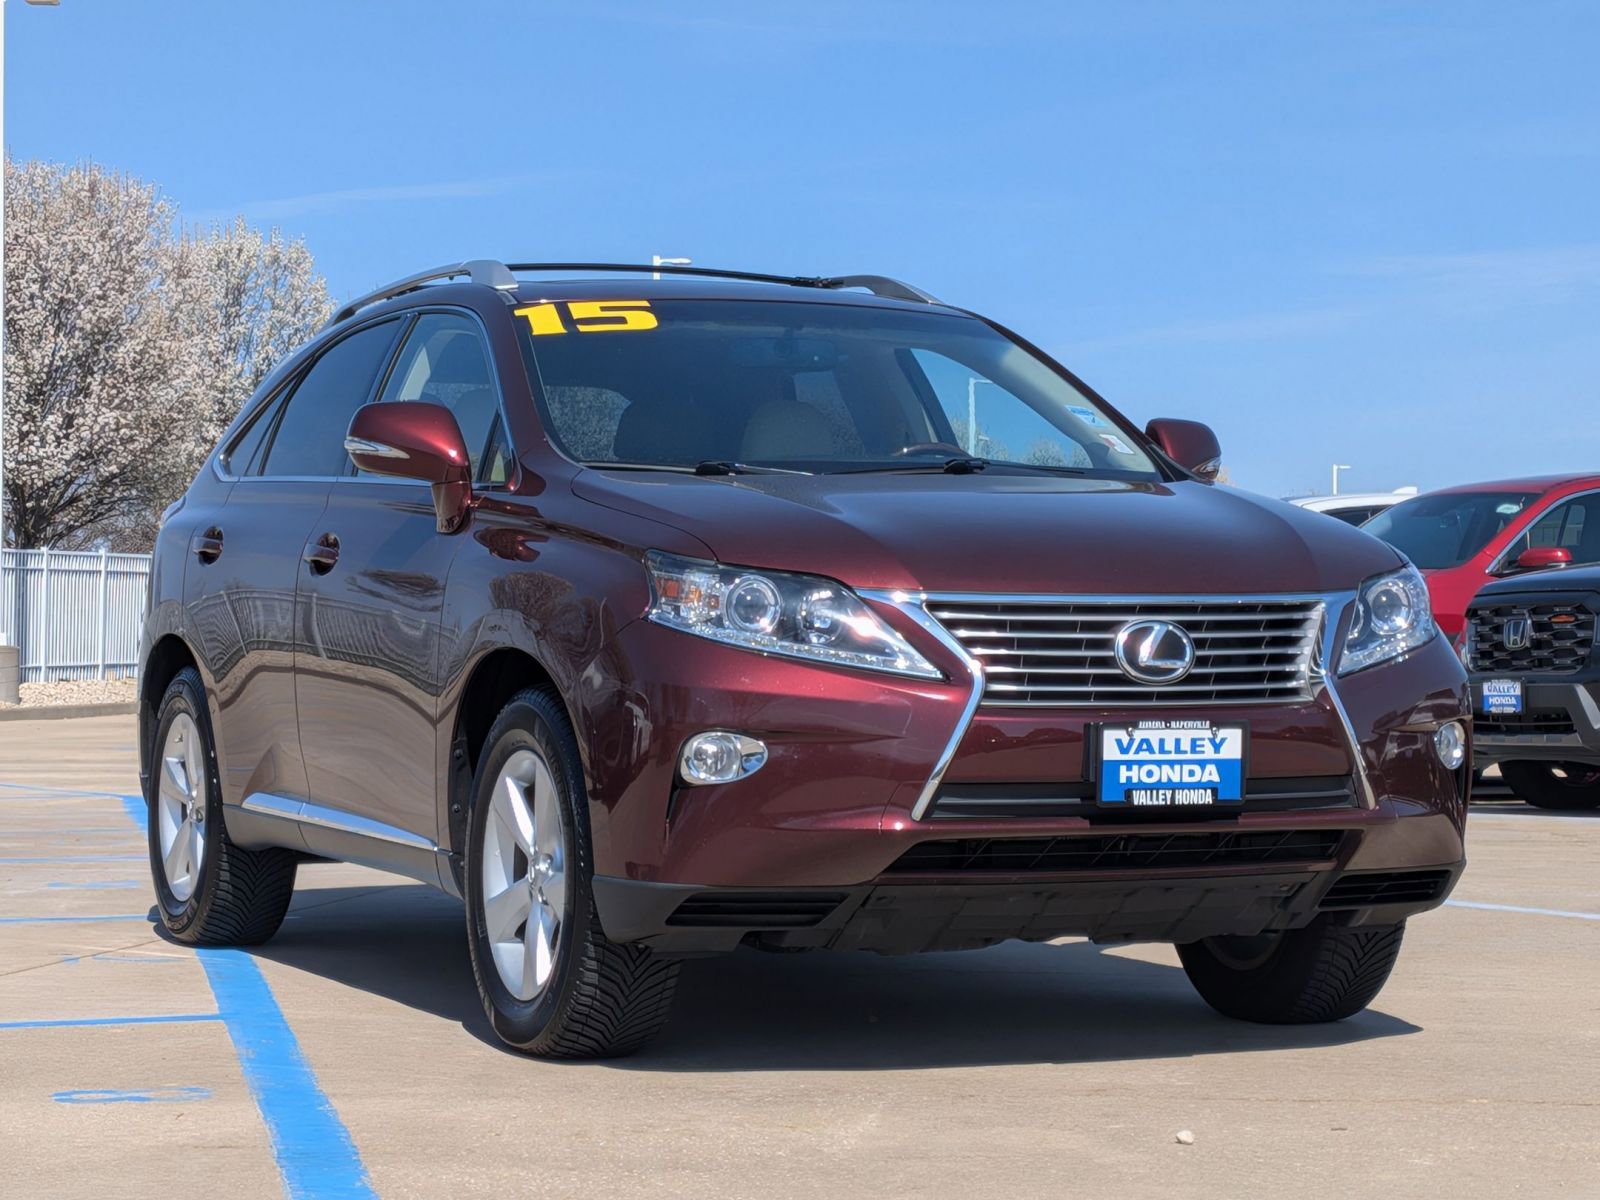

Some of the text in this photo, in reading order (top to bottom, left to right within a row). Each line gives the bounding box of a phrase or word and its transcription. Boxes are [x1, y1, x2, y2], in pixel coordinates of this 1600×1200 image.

[513, 300, 658, 335] 15
[1488, 696, 1517, 704] HONDA
[1115, 737, 1228, 754] VALLEY
[1119, 764, 1220, 783] HONDA
[1132, 789, 1212, 805] VALLEY HONDA
